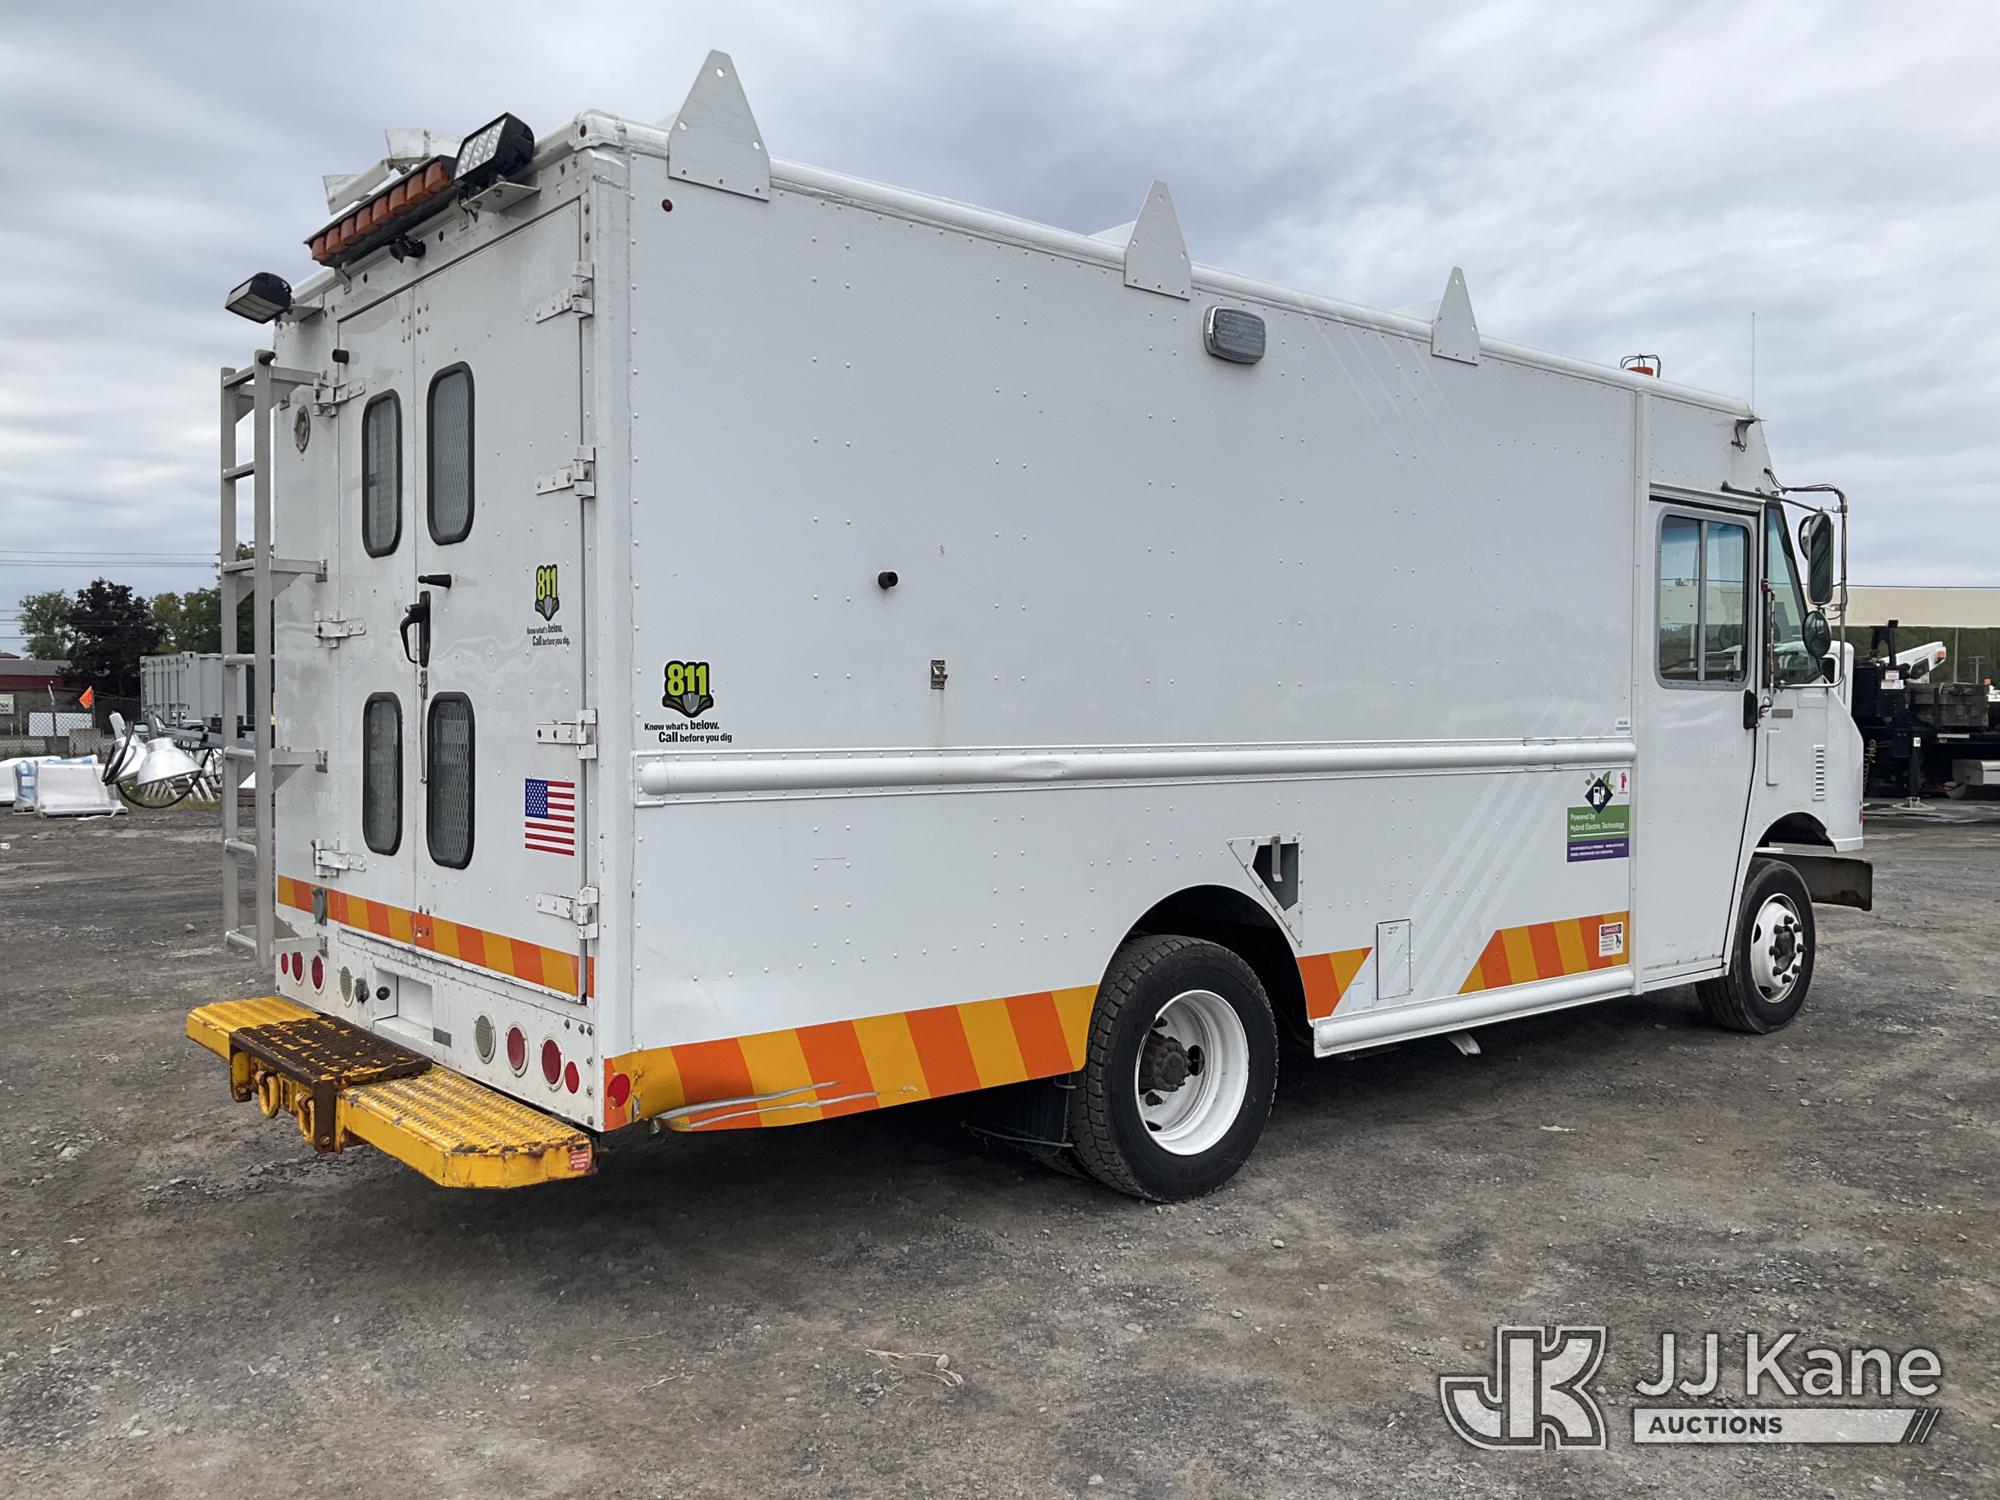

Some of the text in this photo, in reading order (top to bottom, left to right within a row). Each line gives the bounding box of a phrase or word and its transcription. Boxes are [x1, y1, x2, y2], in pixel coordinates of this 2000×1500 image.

[536, 566, 558, 601] 811
[533, 635, 542, 646] Call
[666, 663, 707, 697] 811
[644, 719, 720, 731] Know what's below.
[658, 731, 733, 744] Call before you dig
[1570, 813, 1596, 822] Powered by
[1570, 822, 1625, 832] Hybrid Electric Technology
